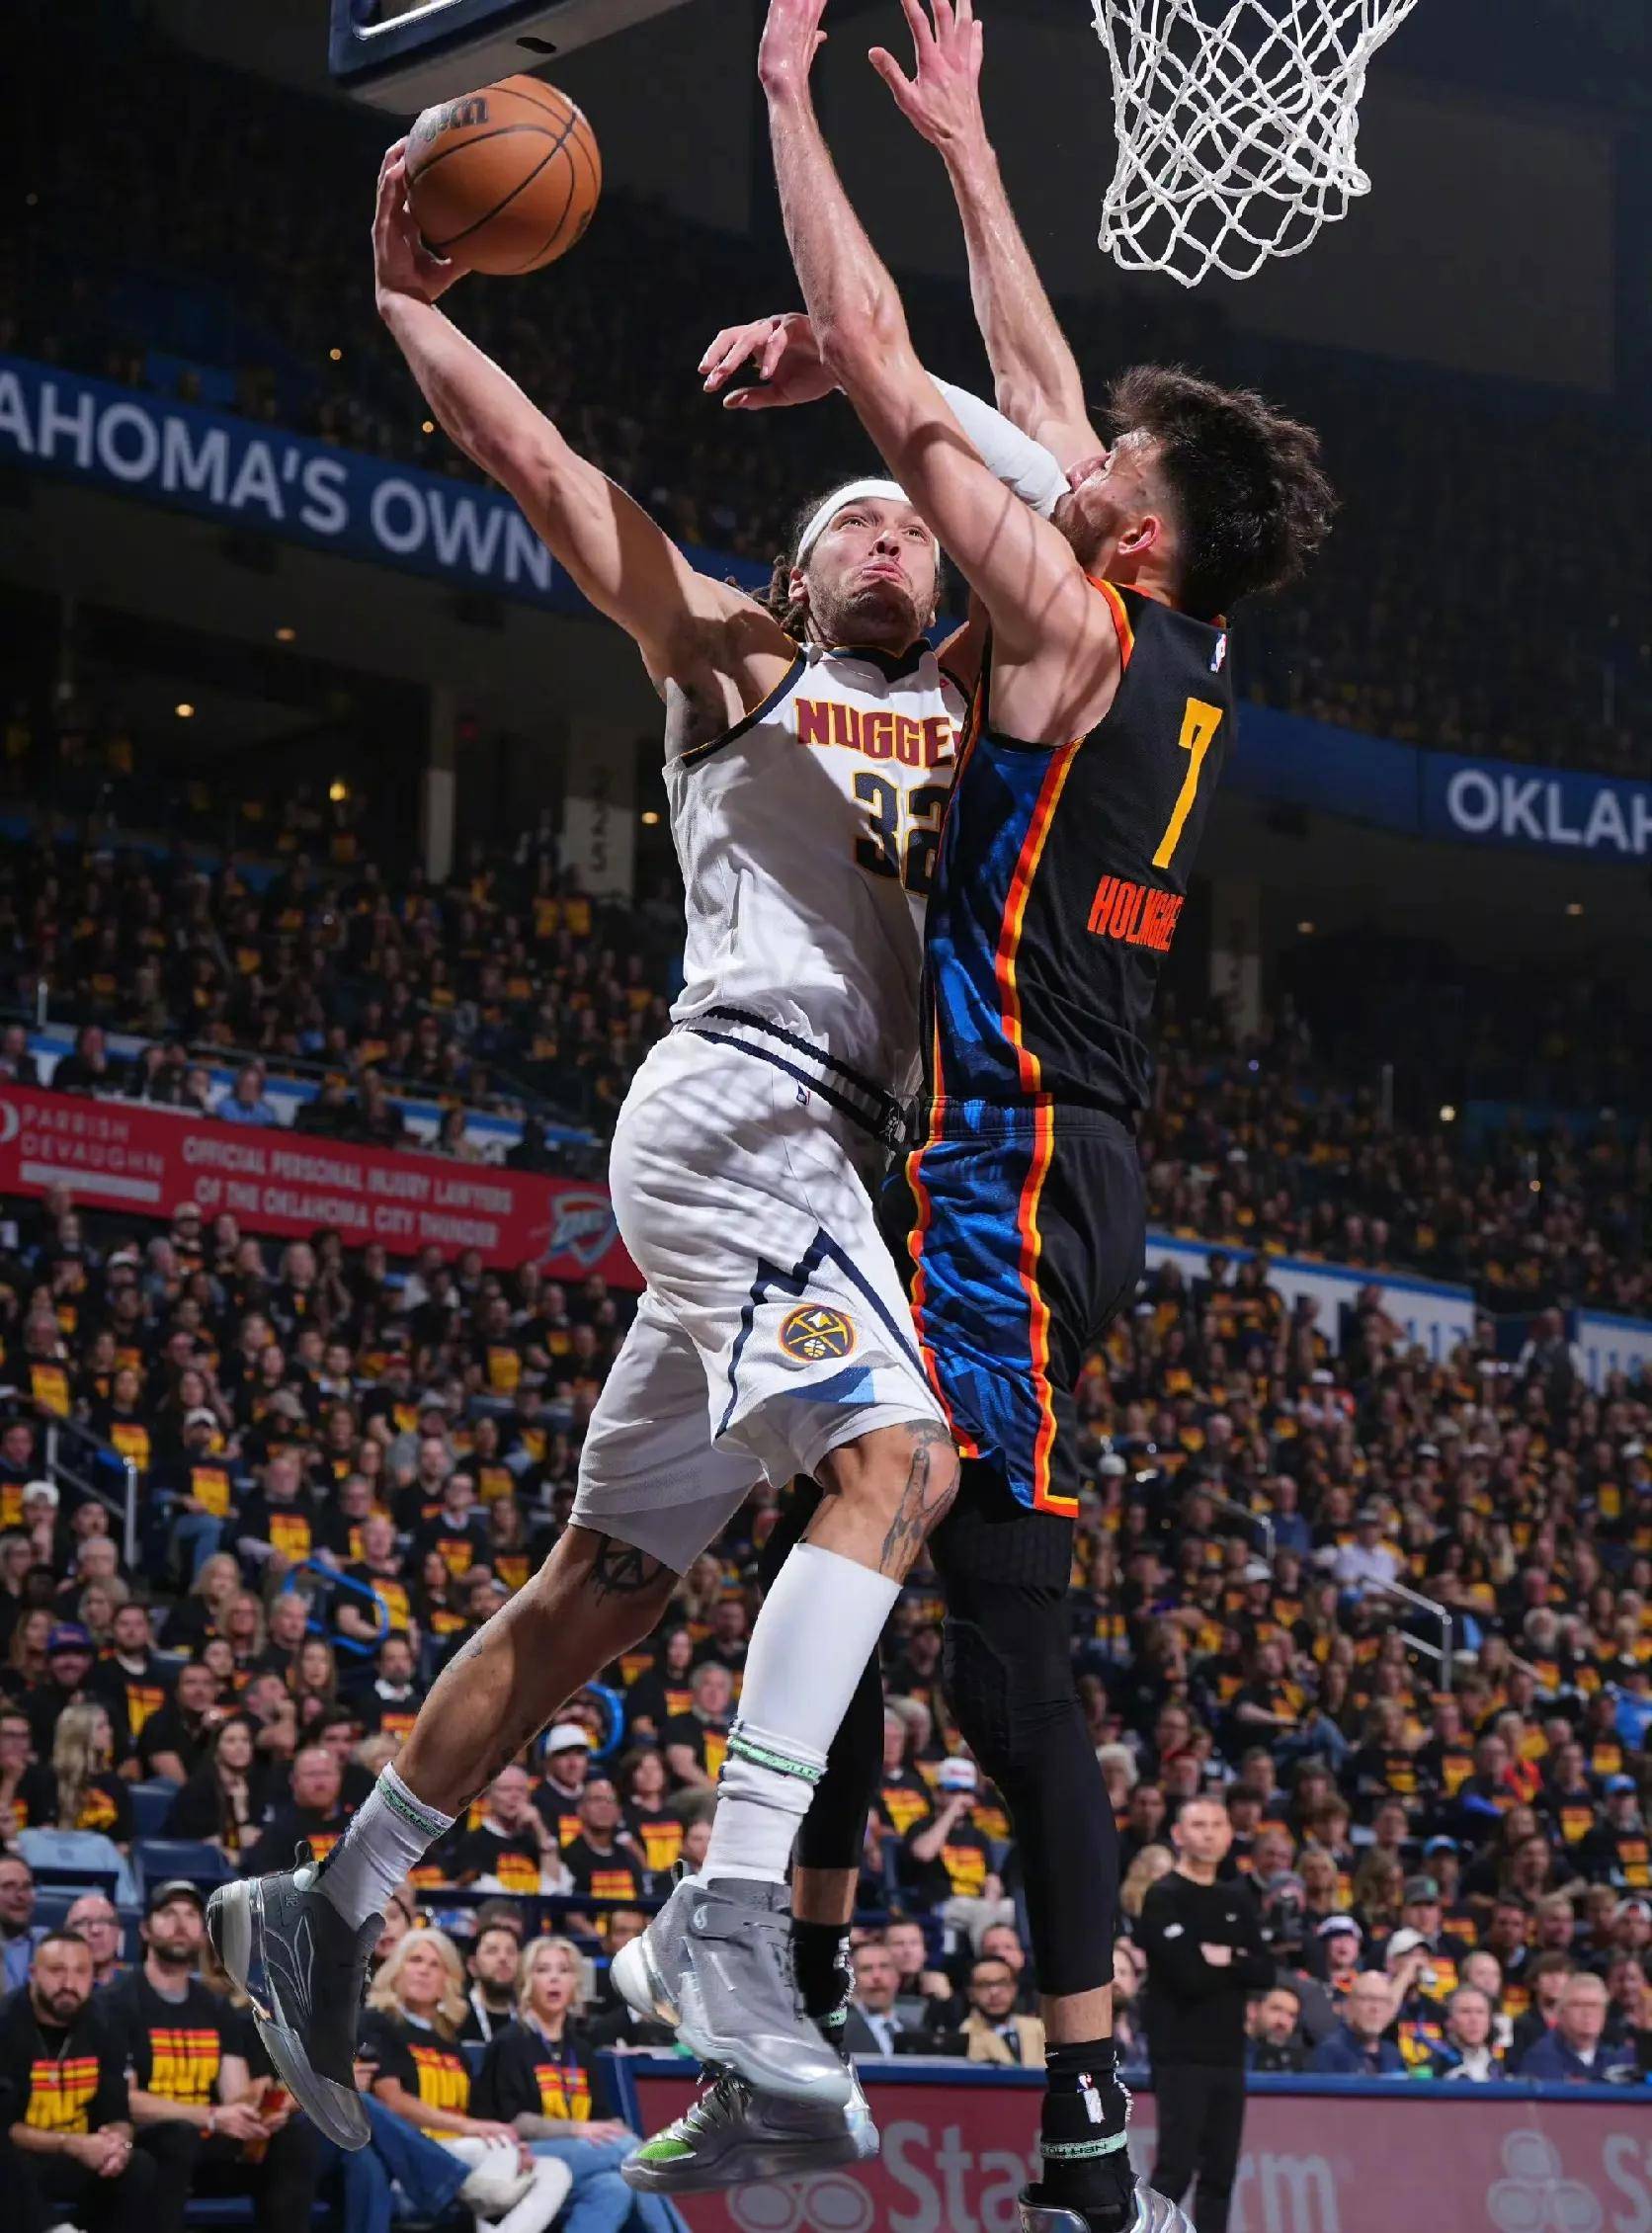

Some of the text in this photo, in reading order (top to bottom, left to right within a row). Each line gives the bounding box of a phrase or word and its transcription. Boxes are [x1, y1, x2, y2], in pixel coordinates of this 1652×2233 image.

[0, 372, 552, 590] AHOMA'S OWN
[794, 697, 961, 769] NUGGE
[1151, 697, 1223, 868] 7
[852, 769, 949, 898] 32
[883, 2119, 1045, 2233] Sta
[1603, 2134, 1652, 2233] S
